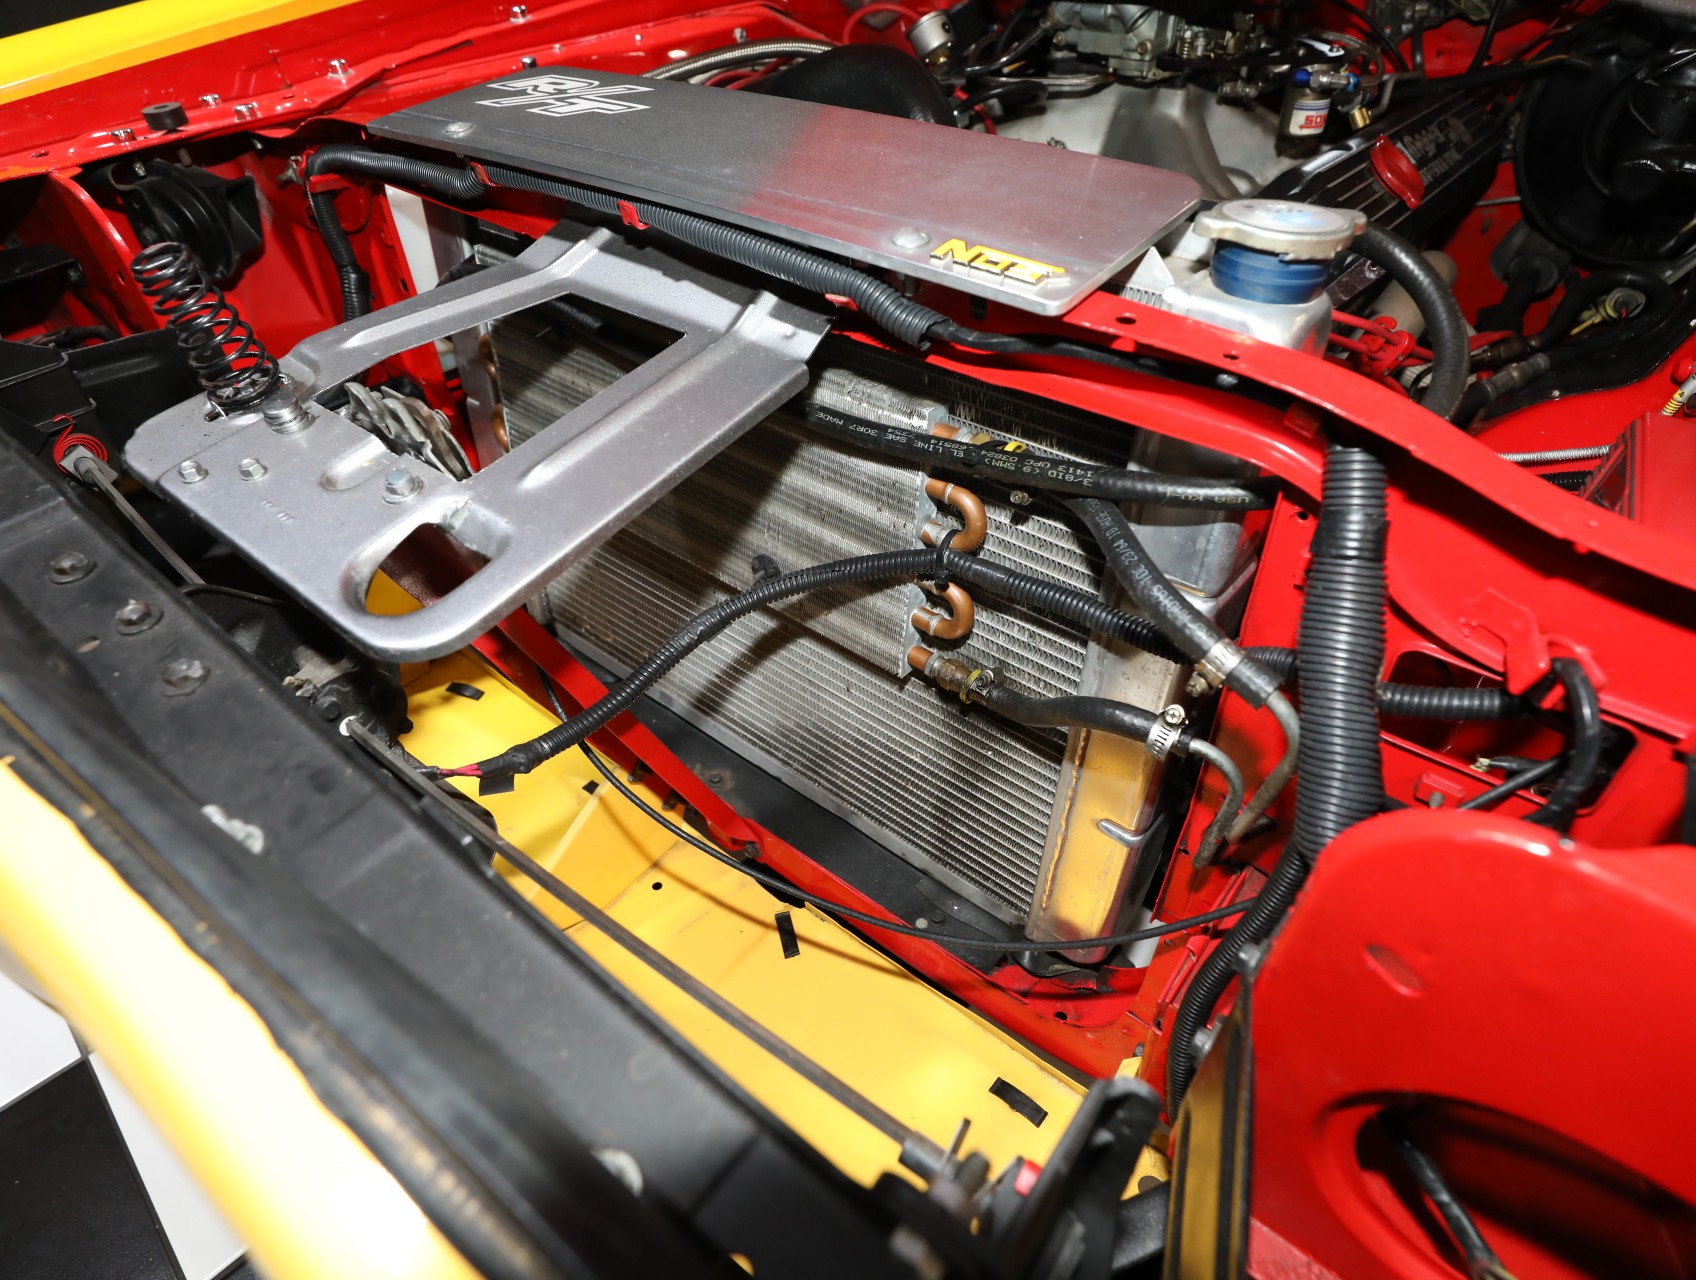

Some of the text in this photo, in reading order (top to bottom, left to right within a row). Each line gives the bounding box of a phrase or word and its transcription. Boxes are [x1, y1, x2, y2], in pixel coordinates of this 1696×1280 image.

[475, 74, 654, 117] R/T
[930, 238, 1067, 284] NOS
[815, 412, 843, 424] MADE
[884, 432, 907, 442] SAE
[912, 439, 942, 453] LINE
[1025, 458, 1051, 468] UPC
[1058, 464, 1093, 476] 1413
[1214, 495, 1249, 504] USA
